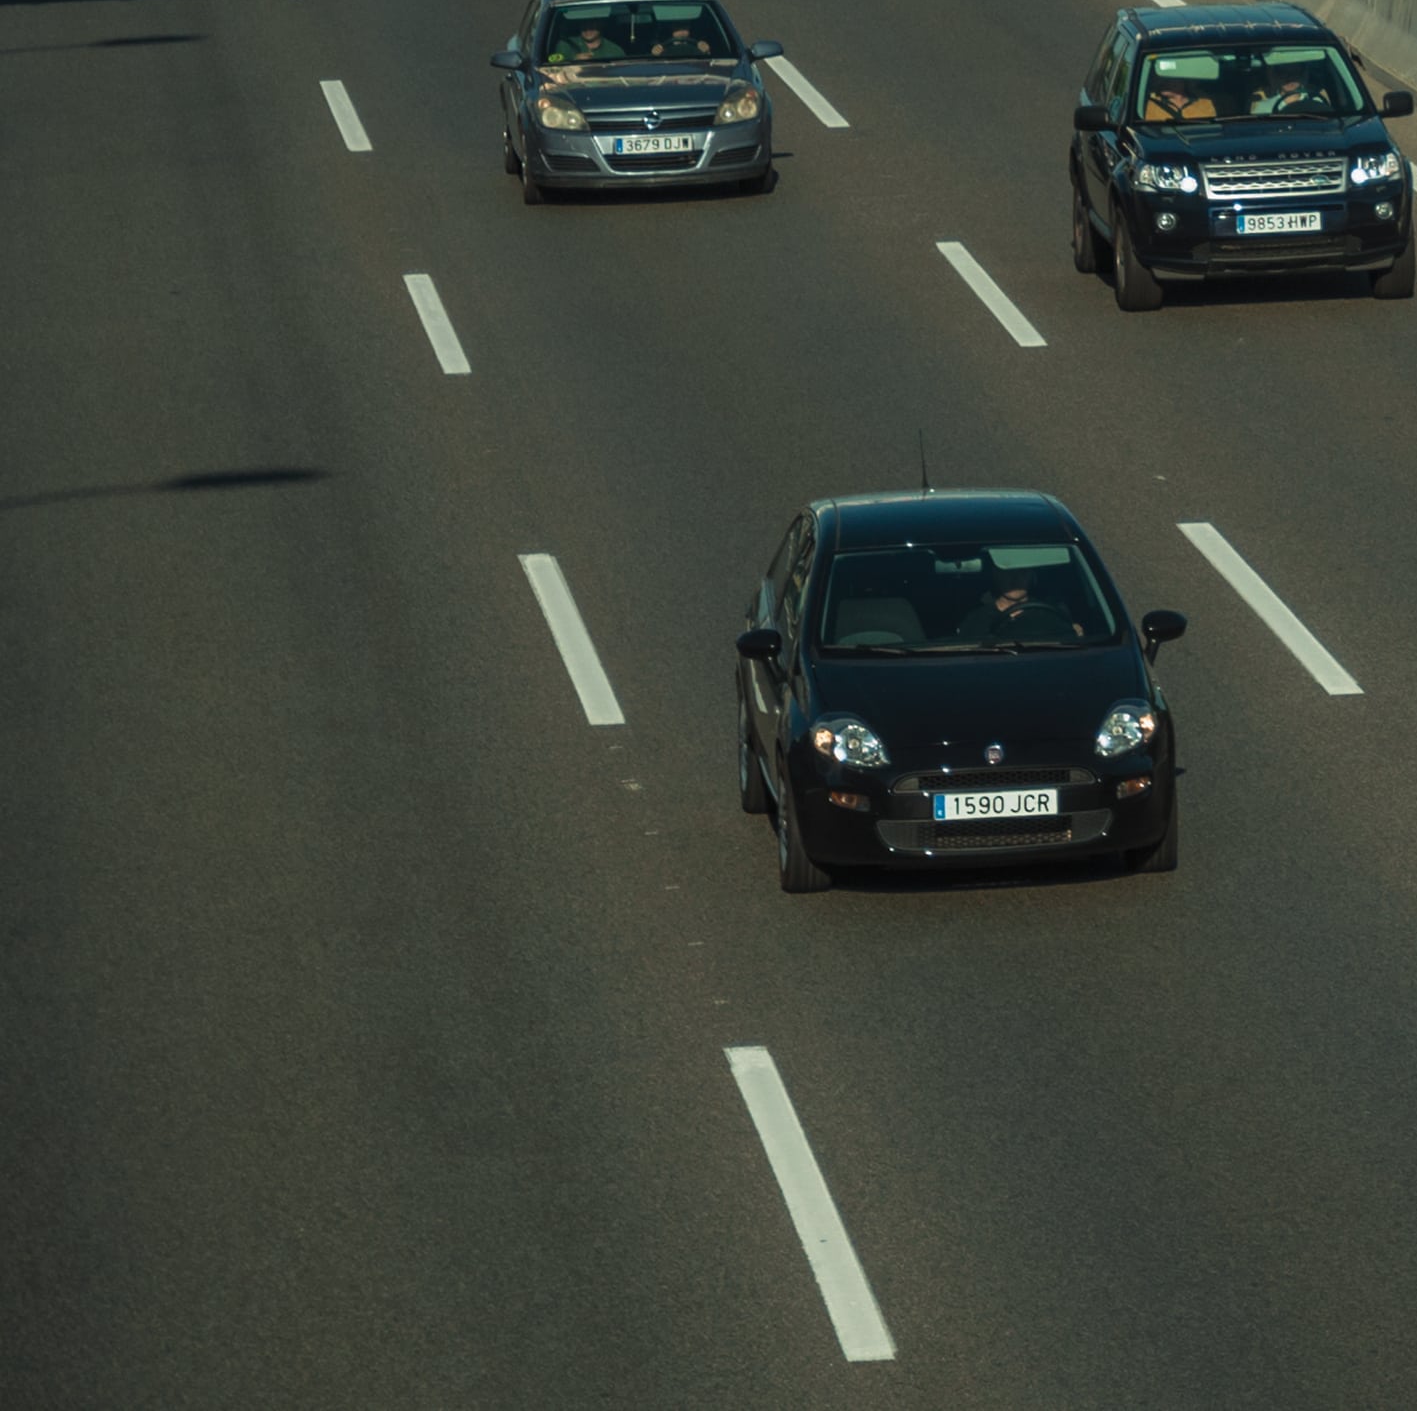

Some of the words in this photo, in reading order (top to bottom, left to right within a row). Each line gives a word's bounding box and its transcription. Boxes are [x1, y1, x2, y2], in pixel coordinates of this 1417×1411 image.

[626, 138, 660, 152] 3679
[1247, 216, 1285, 231] 9853
[1288, 214, 1317, 228] HWP
[954, 795, 1005, 816] 1590
[1010, 793, 1050, 814] JCR
